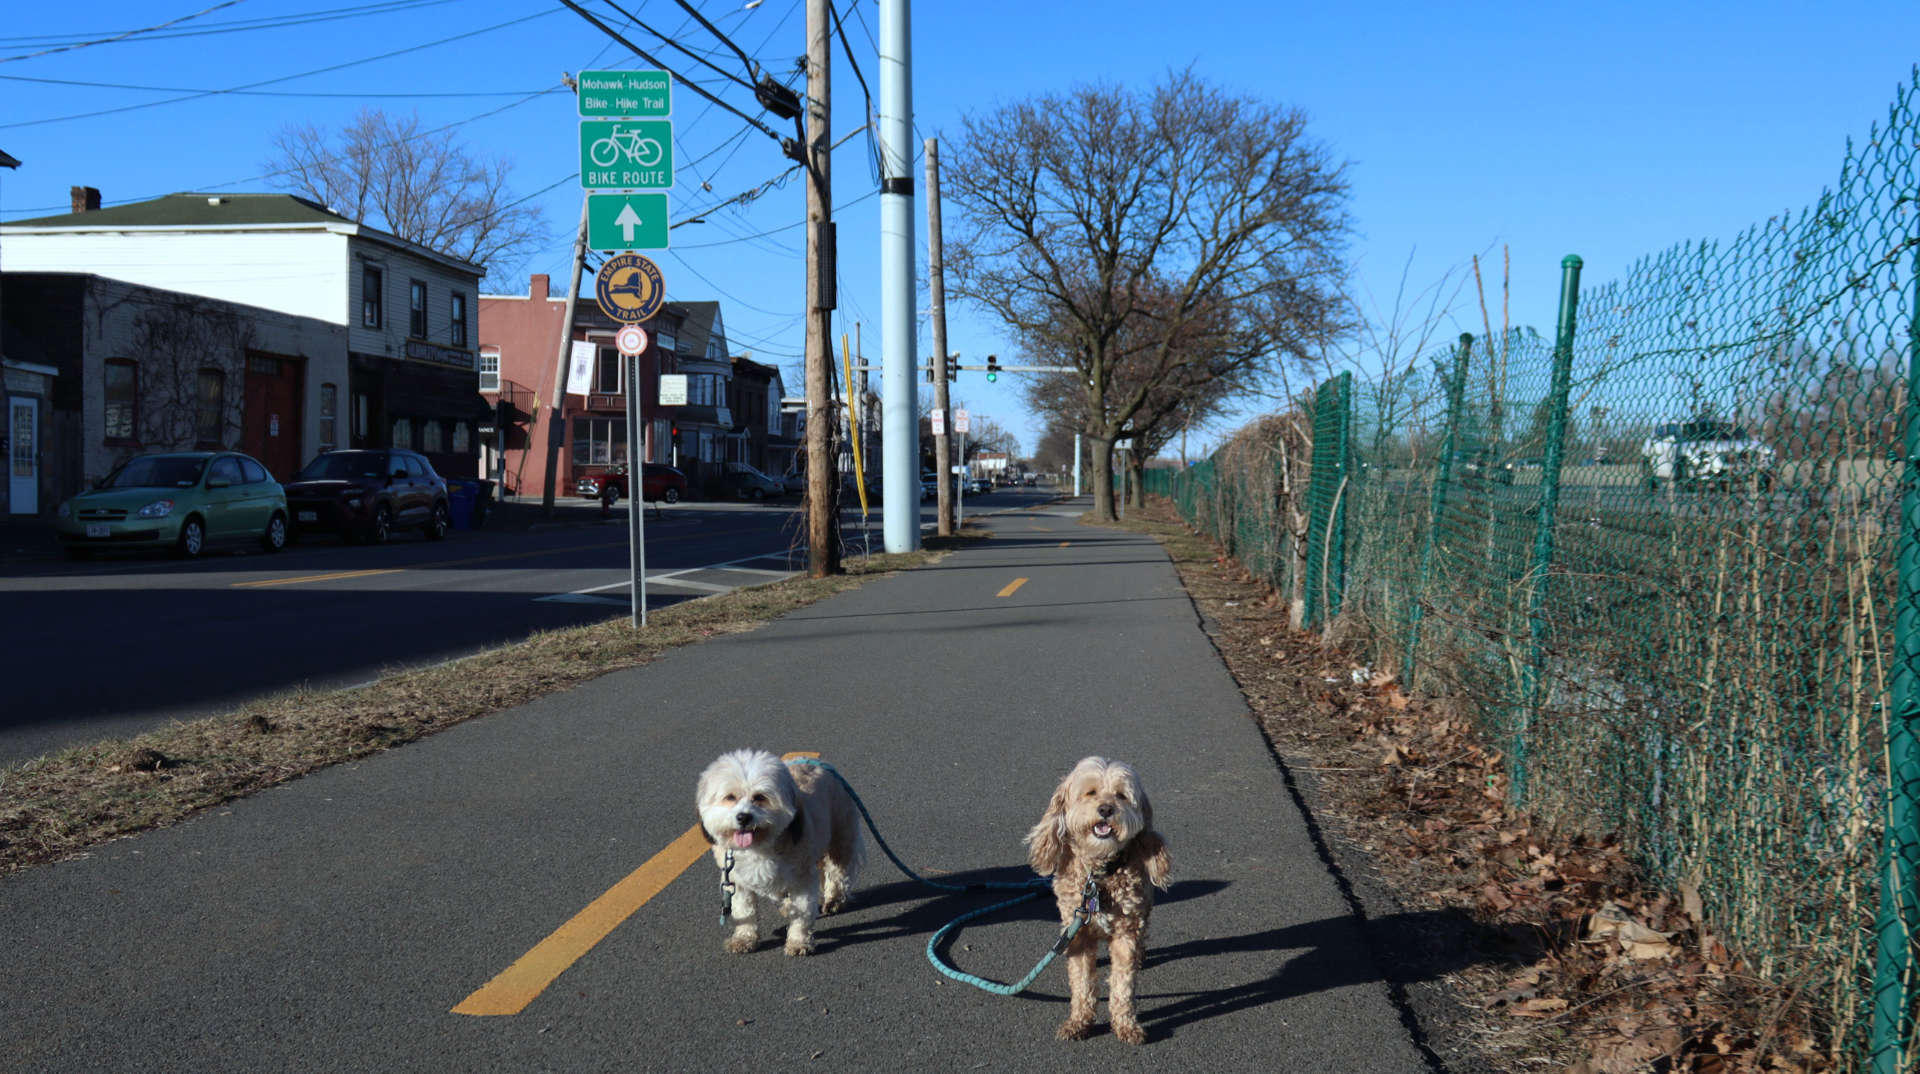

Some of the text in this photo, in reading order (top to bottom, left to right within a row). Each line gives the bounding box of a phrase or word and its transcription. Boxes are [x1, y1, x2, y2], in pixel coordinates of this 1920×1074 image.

[643, 97, 664, 109] Trail
[588, 171, 665, 184] BIKE ROUTE
[601, 257, 659, 281] EMPIRE STATE
[616, 309, 646, 319] TRAIL
